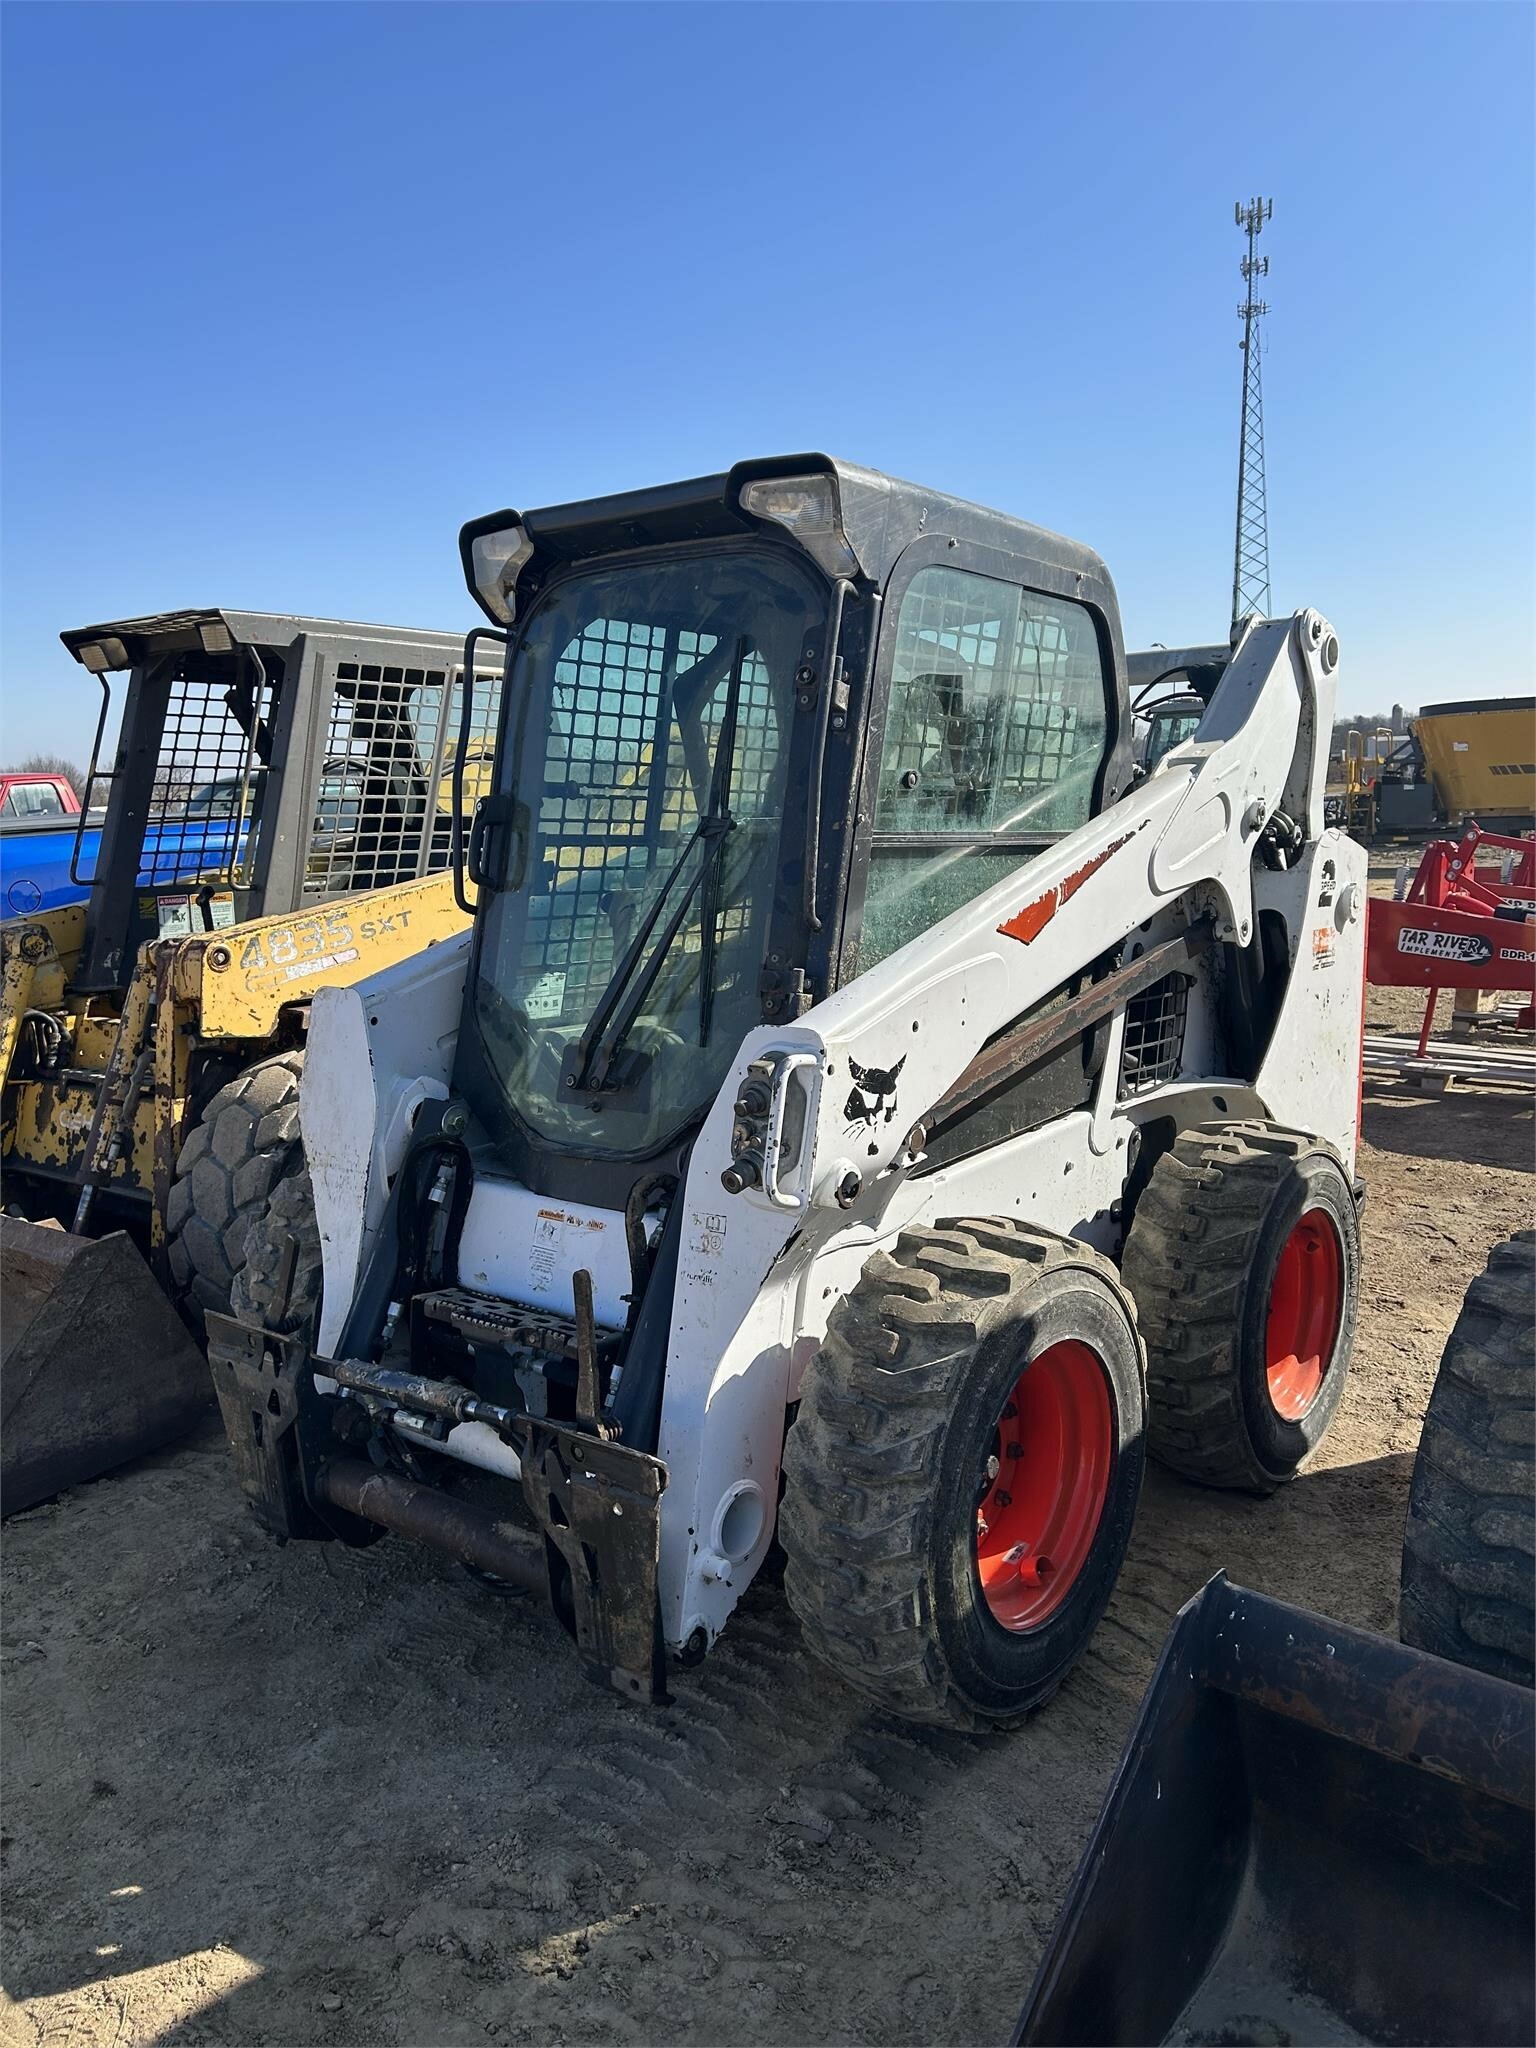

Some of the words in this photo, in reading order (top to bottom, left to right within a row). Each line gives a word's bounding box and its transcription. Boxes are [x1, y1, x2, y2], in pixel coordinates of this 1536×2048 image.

[240, 912, 354, 970] 4835
[360, 910, 412, 939] SXT
[1401, 929, 1428, 946] TAR
[1433, 934, 1480, 953] RIVER
